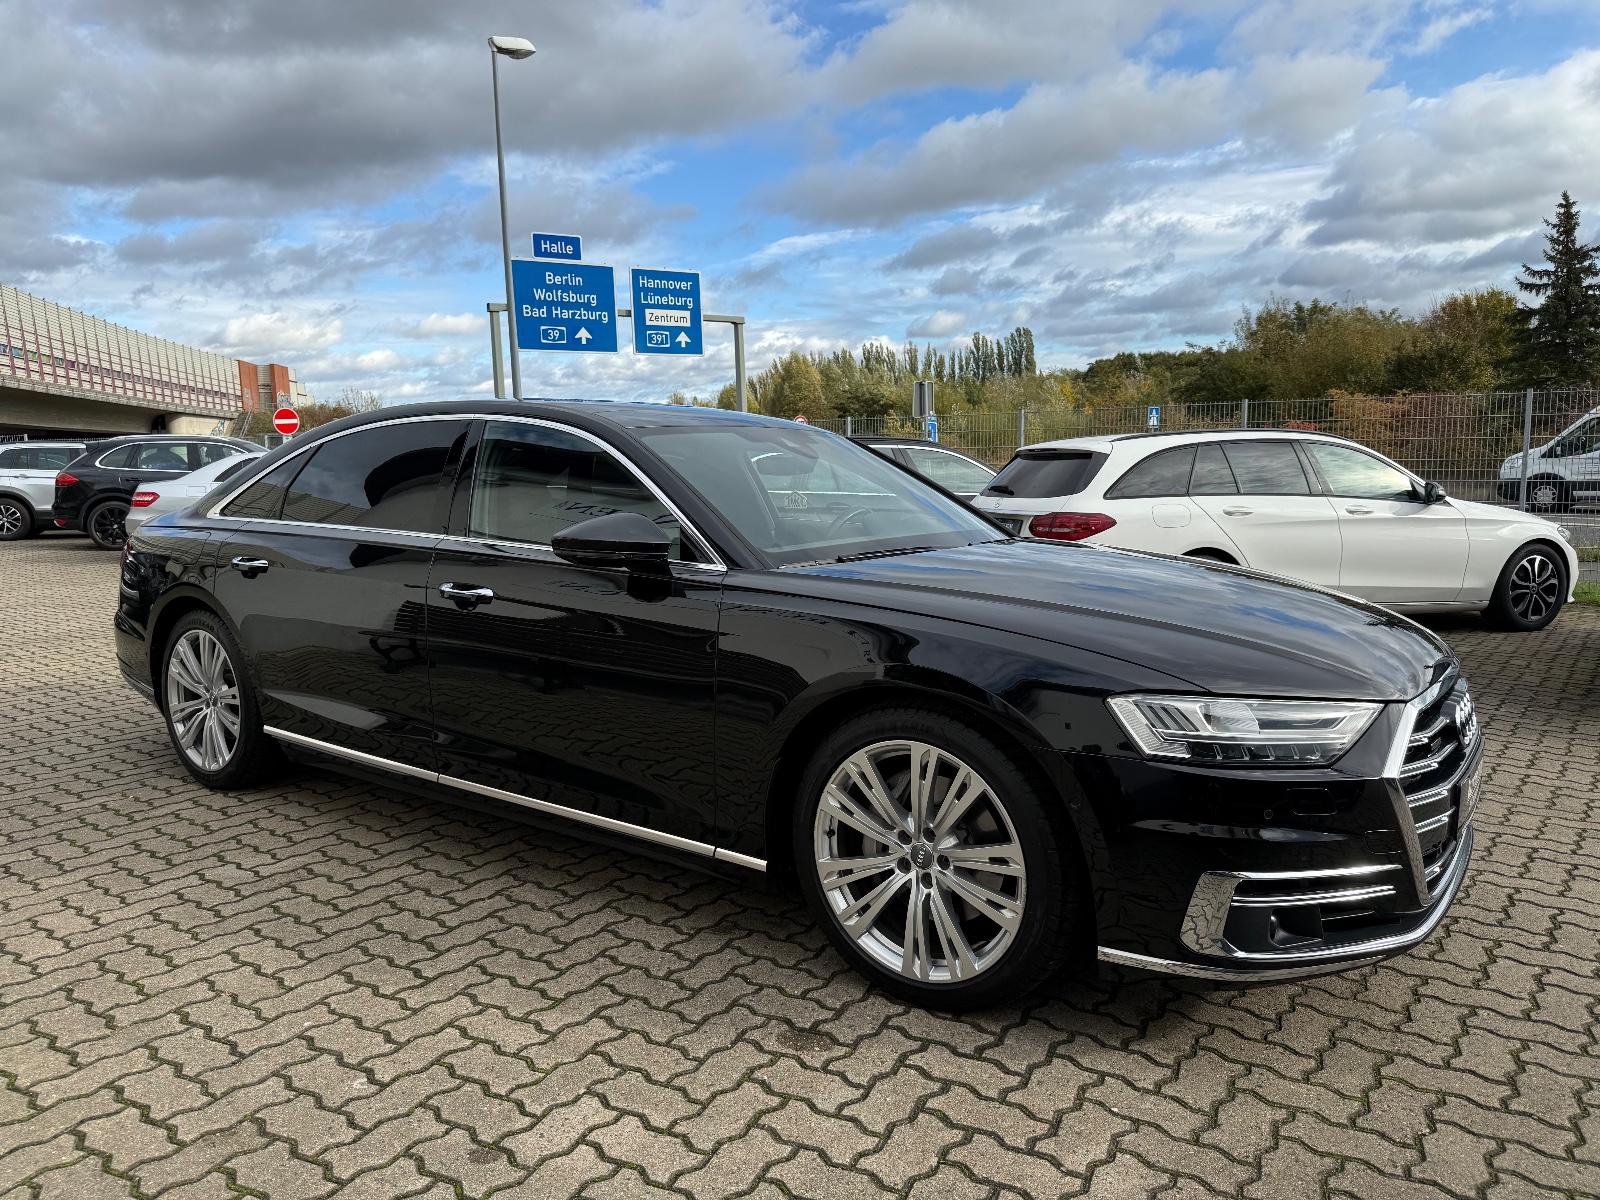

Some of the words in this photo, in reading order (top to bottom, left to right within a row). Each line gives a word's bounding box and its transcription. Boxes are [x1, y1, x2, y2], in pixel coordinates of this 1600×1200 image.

[541, 240, 574, 254] Halle
[545, 272, 584, 286] Berlin
[639, 276, 693, 291] Hannover
[533, 289, 598, 306] Wolfsburg
[640, 292, 693, 309] Lüneburg
[523, 305, 547, 319] Bad
[552, 307, 608, 323] Harzburg
[648, 312, 688, 324] Zentrum
[547, 329, 560, 341] 39
[651, 334, 667, 345] 391
